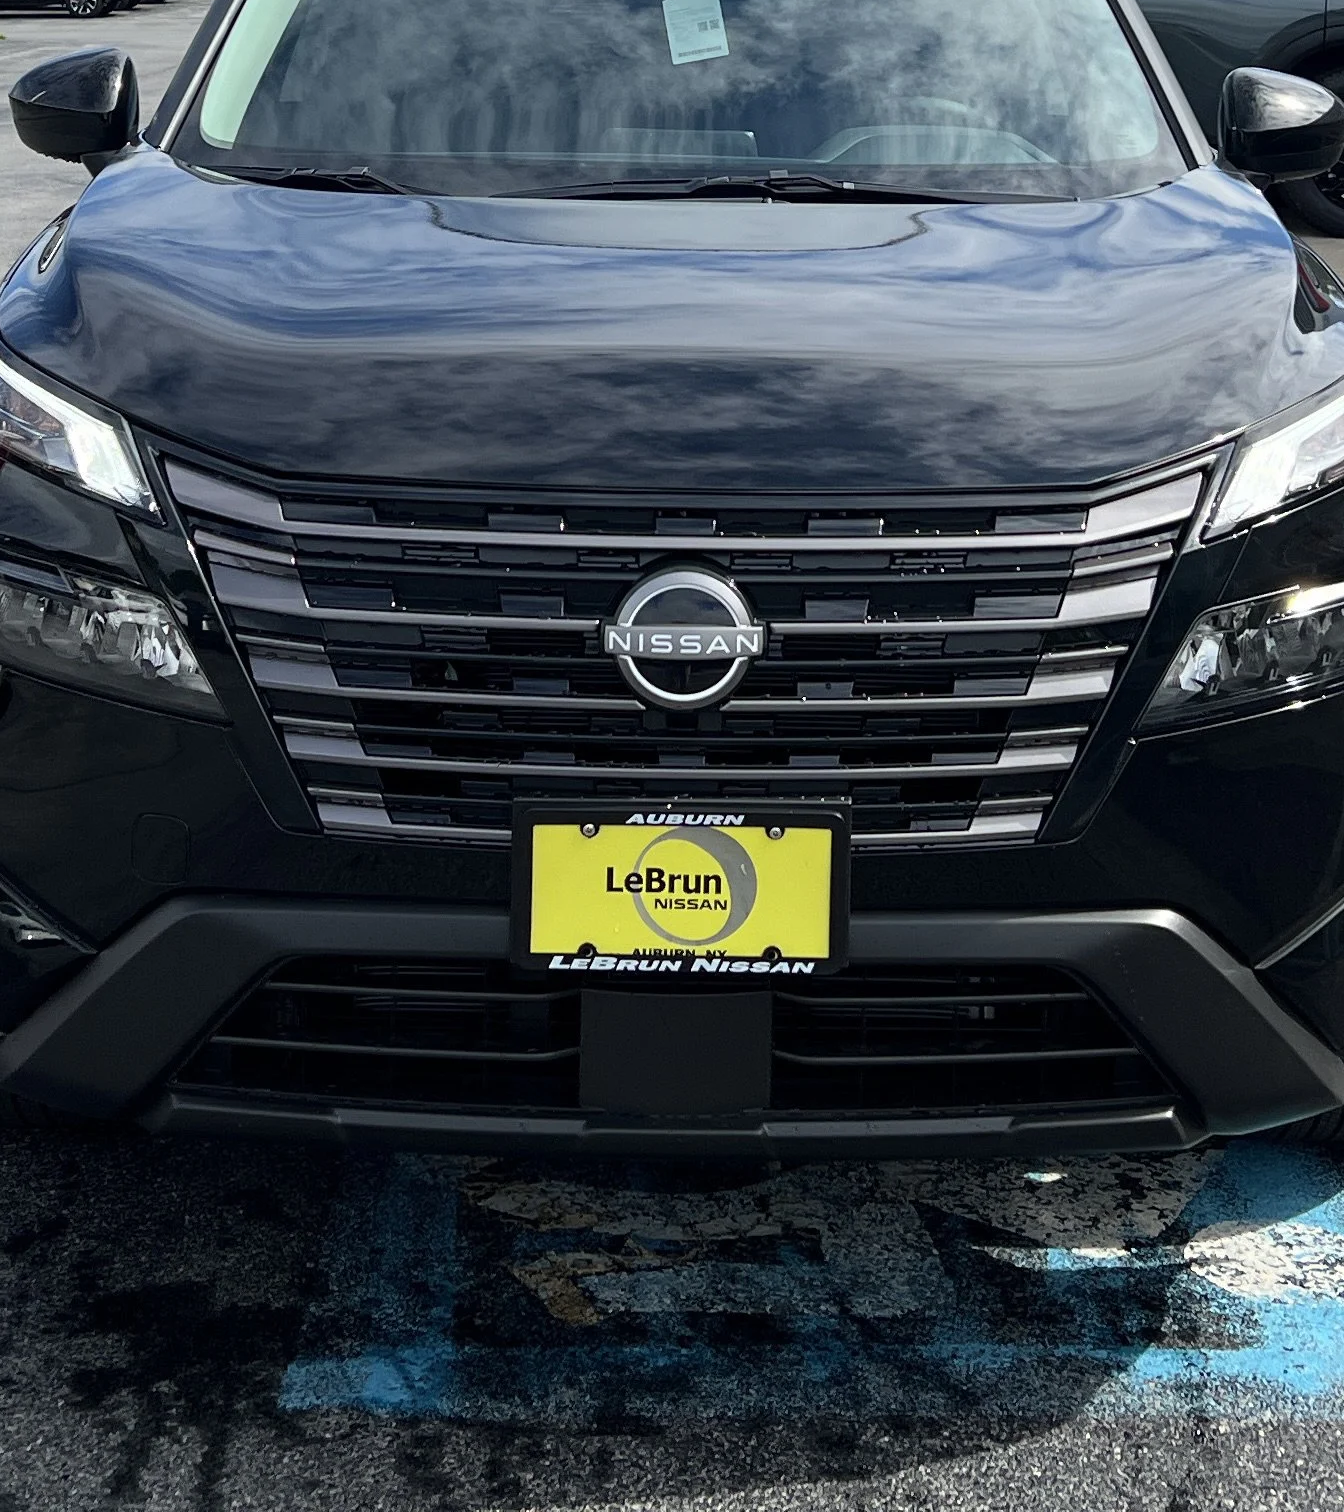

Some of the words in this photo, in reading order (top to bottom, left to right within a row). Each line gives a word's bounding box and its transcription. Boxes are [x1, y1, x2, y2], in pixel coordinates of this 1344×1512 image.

[608, 630, 759, 655] NISSAN
[625, 813, 745, 826] AUBURN
[606, 866, 722, 895] LeBrun
[654, 898, 728, 911] NISSAN
